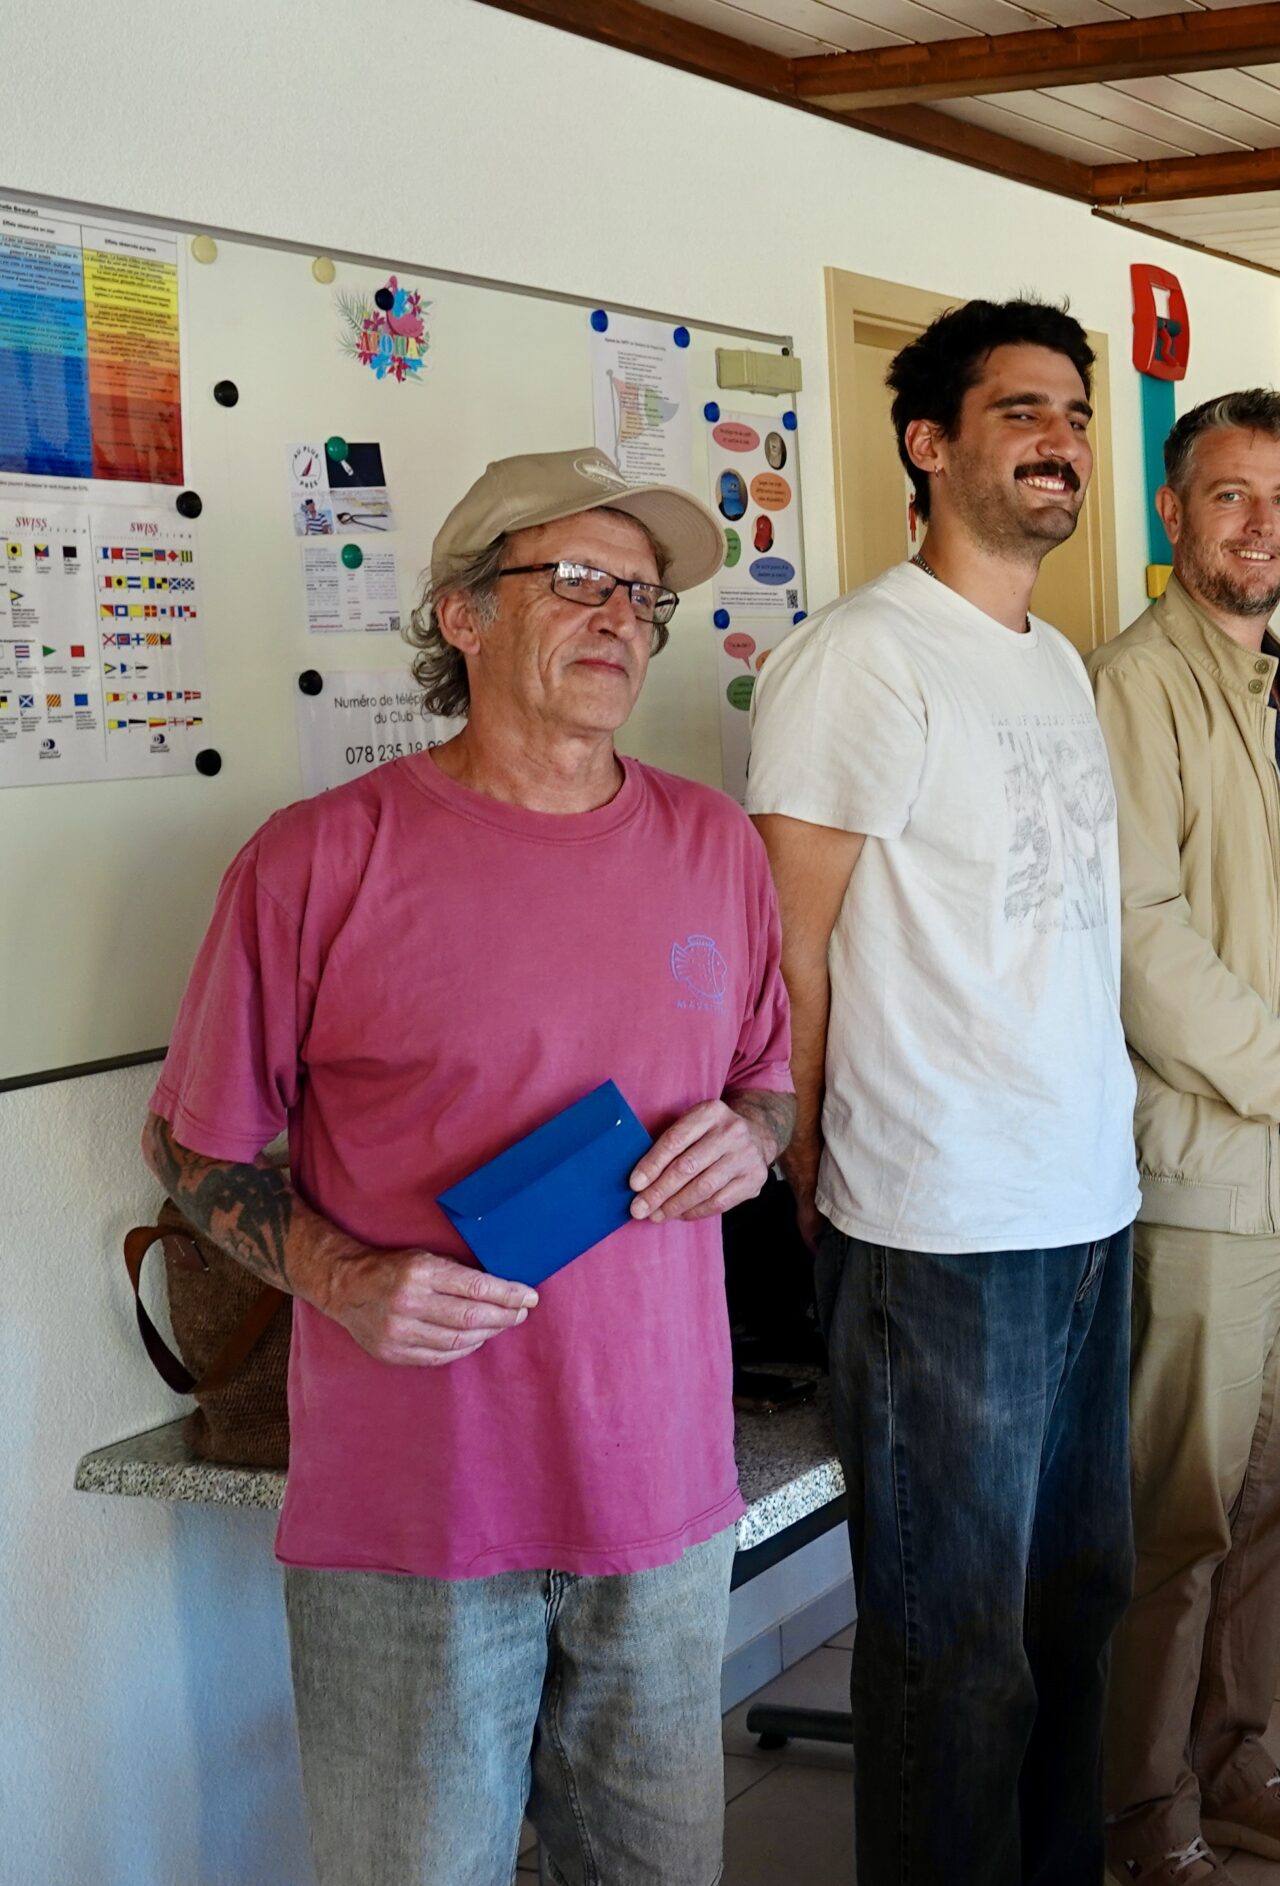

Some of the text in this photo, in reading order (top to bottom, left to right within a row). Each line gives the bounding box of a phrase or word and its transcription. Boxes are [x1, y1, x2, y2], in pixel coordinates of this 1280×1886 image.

[334, 693, 377, 709] Numéro
[380, 694, 393, 706] de
[374, 710, 414, 724] du Club
[345, 746, 375, 765] 078
[378, 742, 404, 762] 235
